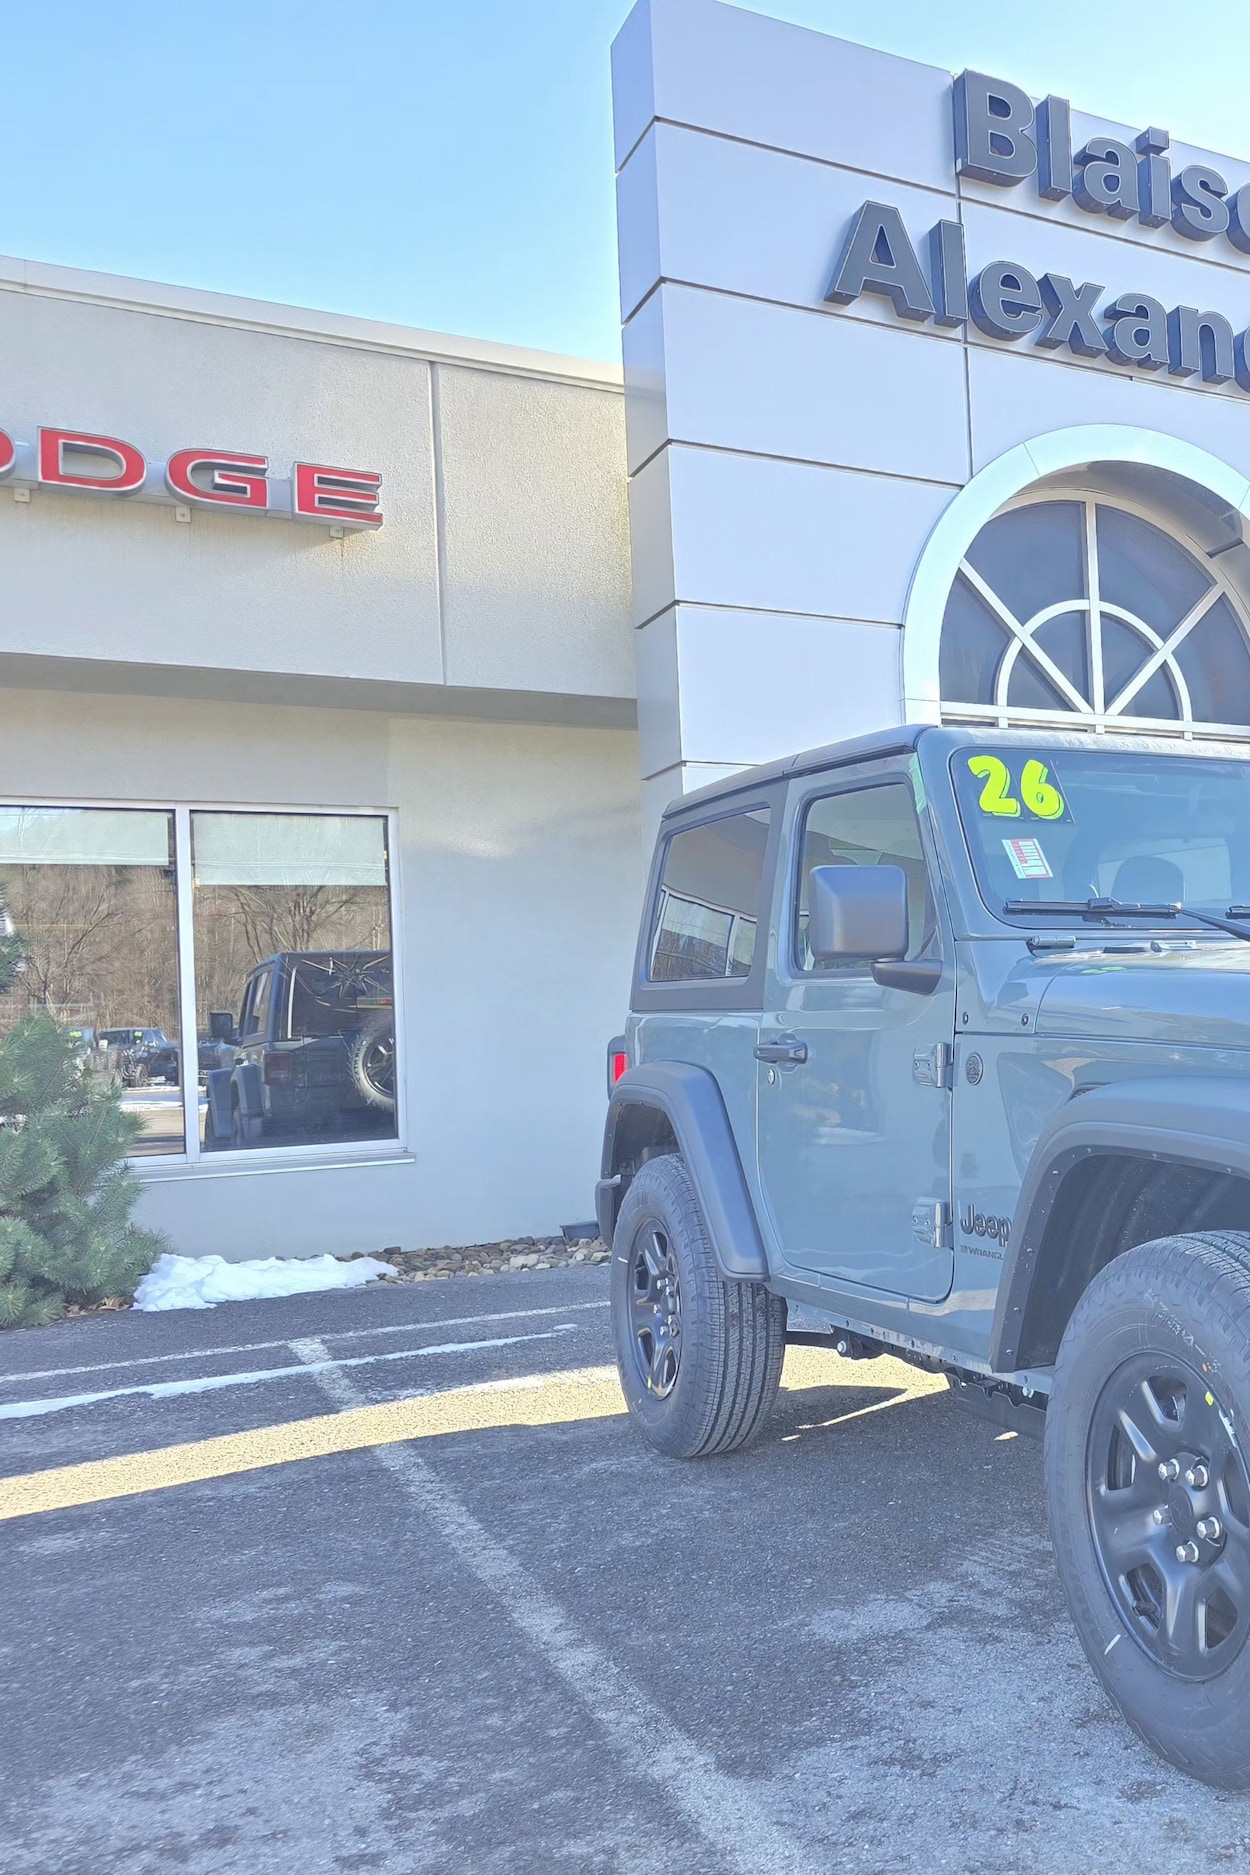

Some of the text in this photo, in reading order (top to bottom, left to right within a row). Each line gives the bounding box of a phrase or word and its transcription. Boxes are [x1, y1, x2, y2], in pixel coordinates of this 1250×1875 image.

[0, 425, 383, 531] DGE
[968, 755, 1065, 820] 26
[960, 1204, 1012, 1248] Jeep
